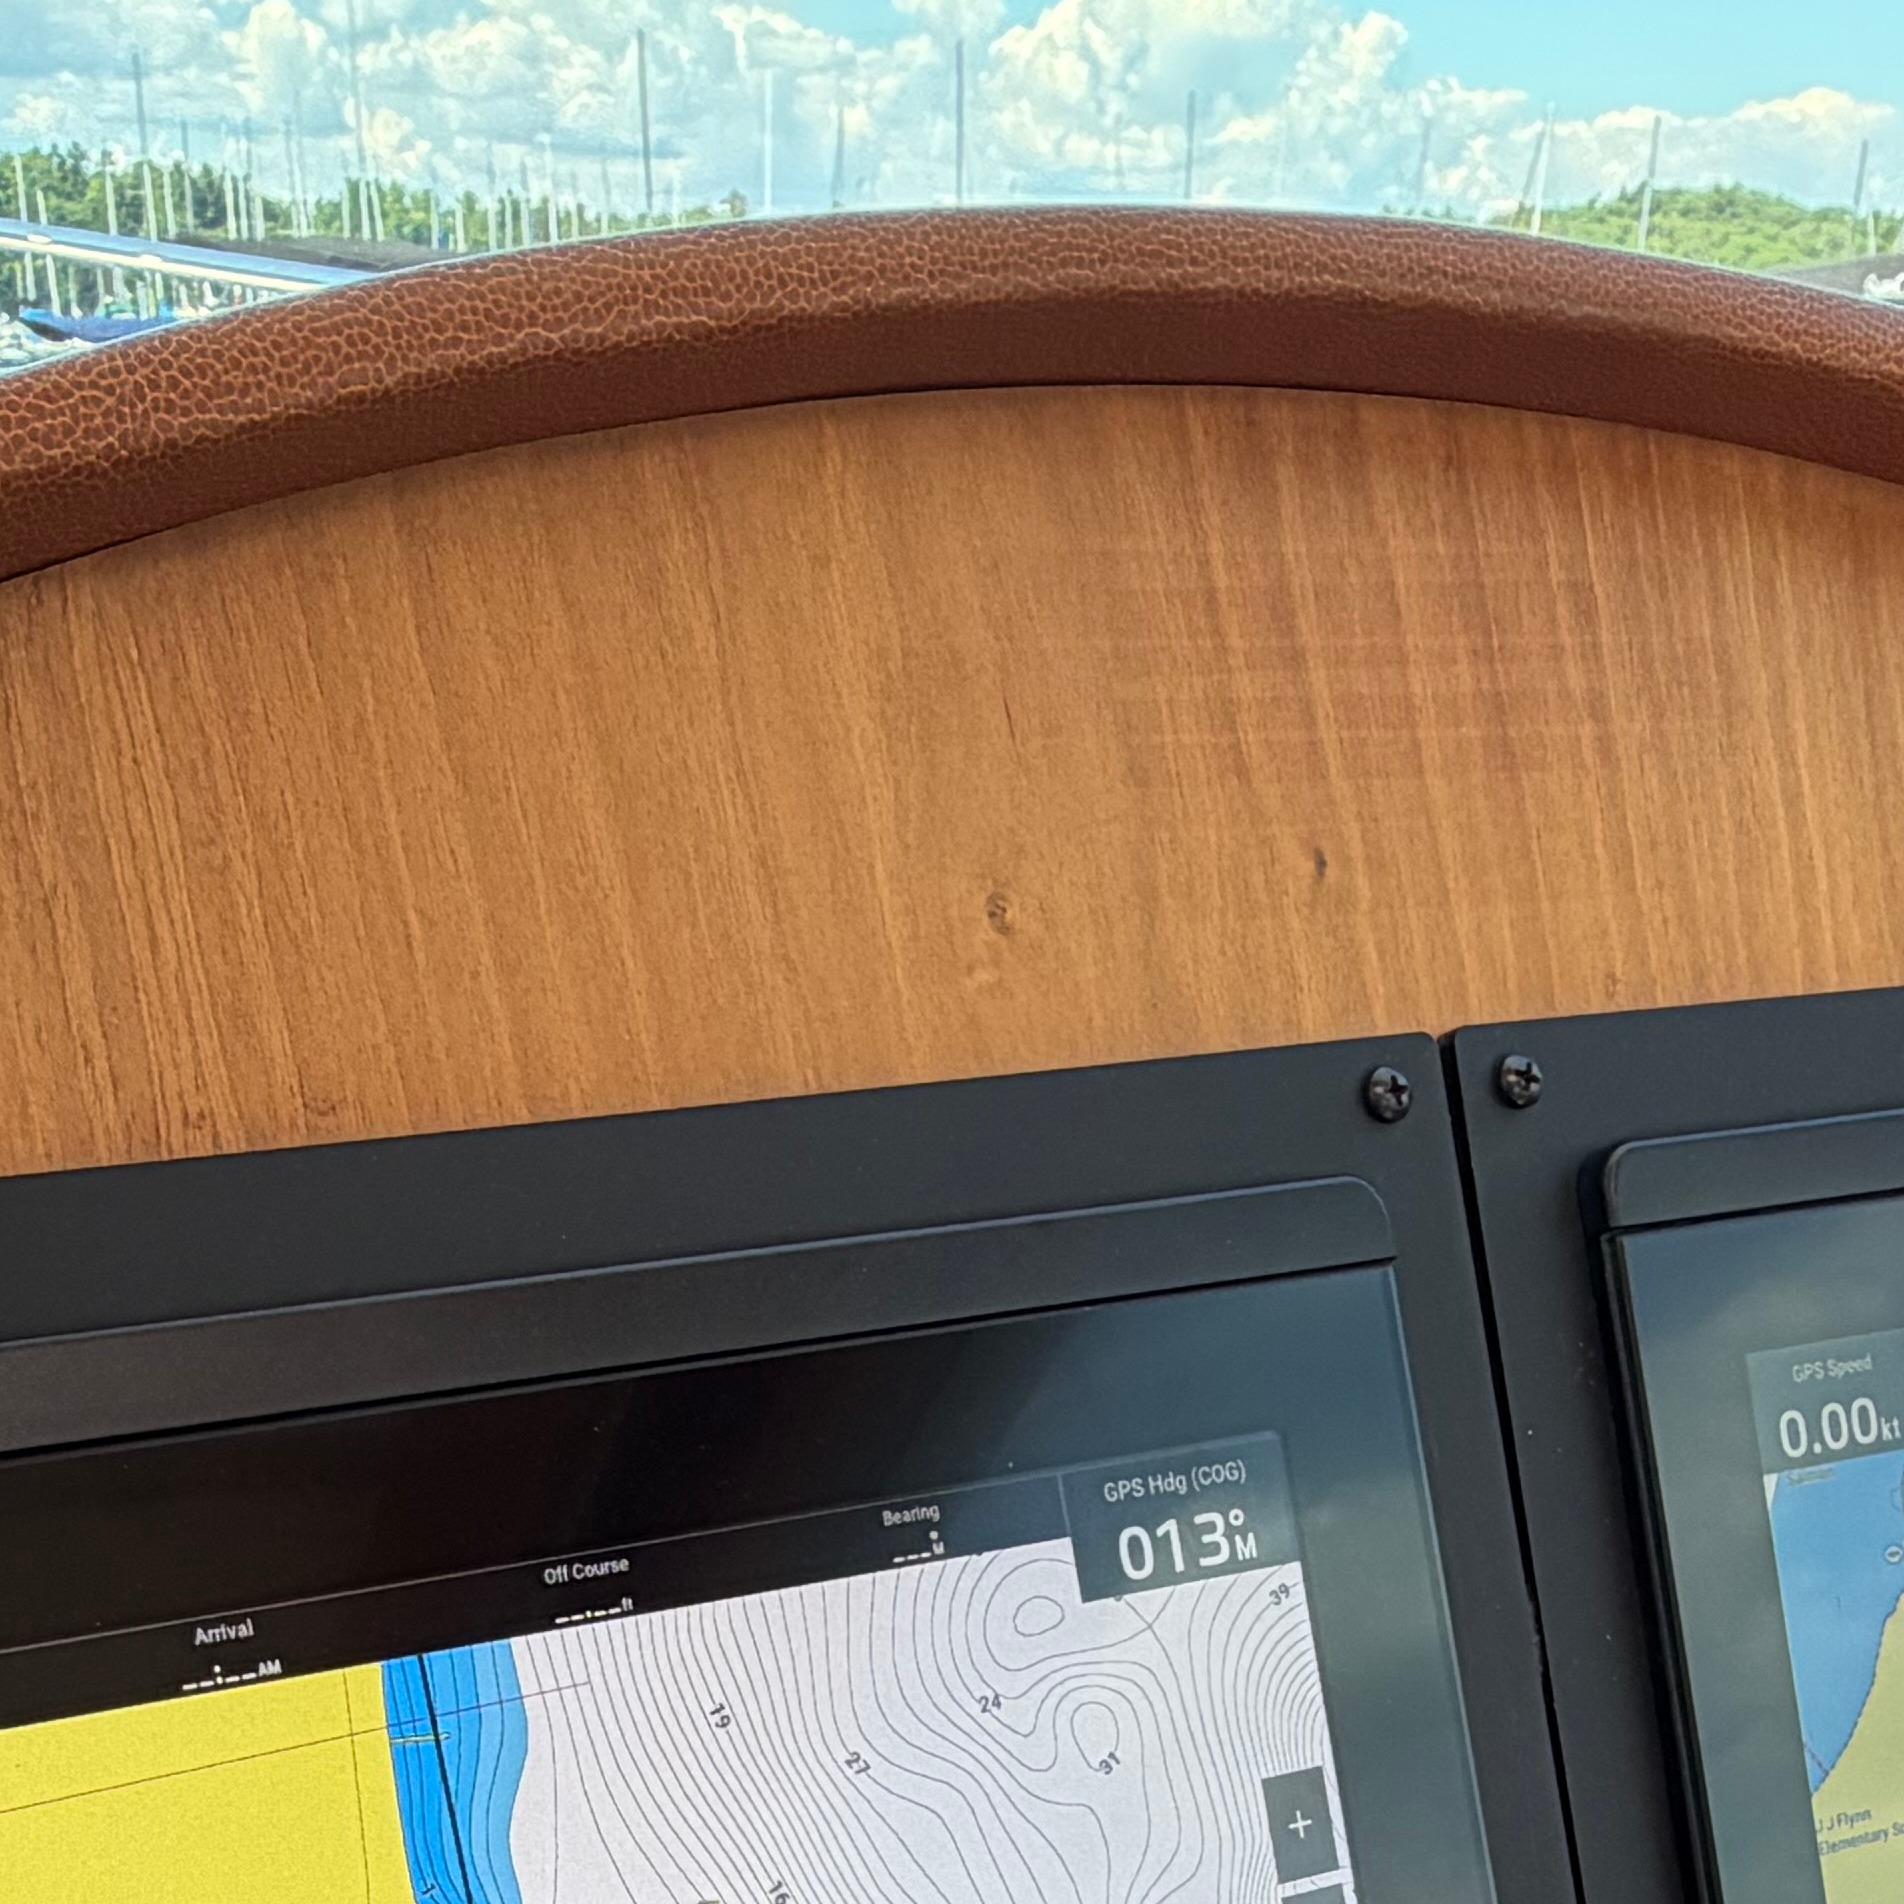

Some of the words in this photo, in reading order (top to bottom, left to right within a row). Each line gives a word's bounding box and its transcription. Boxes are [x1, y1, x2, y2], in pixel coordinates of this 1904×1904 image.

[1793, 1361, 1825, 1383] GPS
[1827, 1353, 1873, 1379] Speed
[1104, 1479, 1144, 1504] GPS
[1149, 1472, 1187, 1498] Hdg
[1191, 1459, 1246, 1491] (COG)
[882, 1505, 940, 1527] Bearing
[544, 1563, 569, 1585] Off
[573, 1558, 630, 1579] Course
[1269, 1583, 1291, 1607] 39
[195, 1619, 254, 1645] Arrival
[979, 1693, 1002, 1713] 24
[710, 1701, 733, 1731] 19
[844, 1752, 870, 1776] 27
[1099, 1751, 1122, 1775] 31
[1836, 1809, 1872, 1829] Flynn
[1819, 1827, 1889, 1856] Elementary
